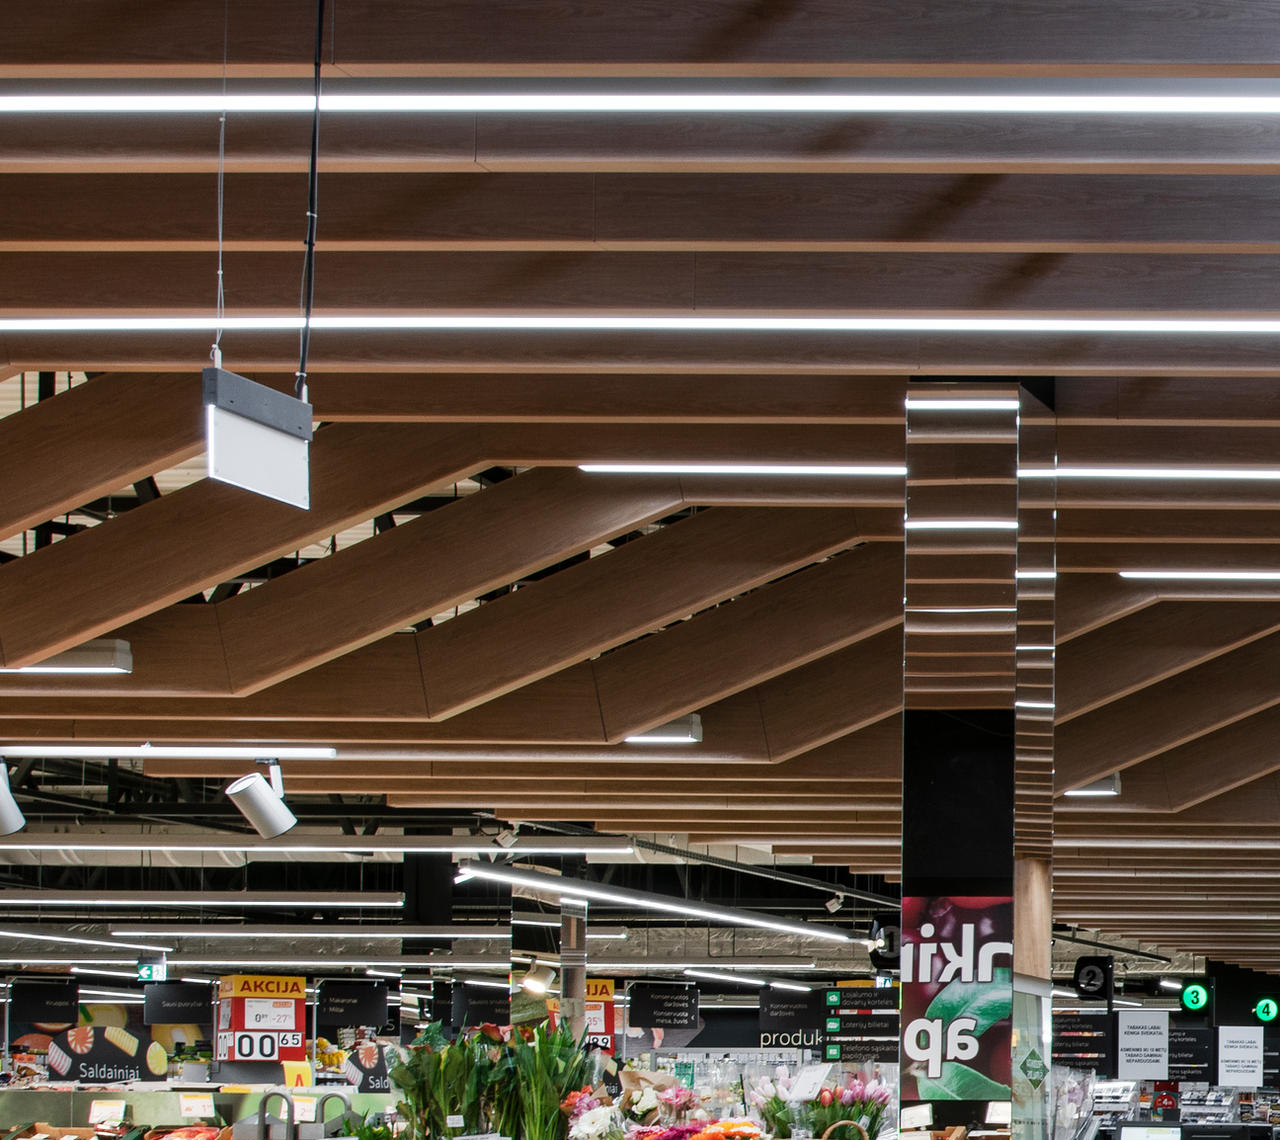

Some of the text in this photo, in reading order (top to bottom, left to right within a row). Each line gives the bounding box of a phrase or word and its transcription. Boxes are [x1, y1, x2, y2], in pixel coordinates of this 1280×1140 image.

[1086, 970, 1096, 986] 2
[240, 980, 301, 993] AKCIJA
[587, 984, 610, 996] IJA
[1191, 989, 1199, 1004] 3
[1262, 1002, 1270, 1016] 4
[238, 1033, 300, 1058] 00 65
[869, 1044, 898, 1053] sąskaito
[79, 1062, 140, 1080] Saldainiai
[368, 1076, 389, 1089] Sald
